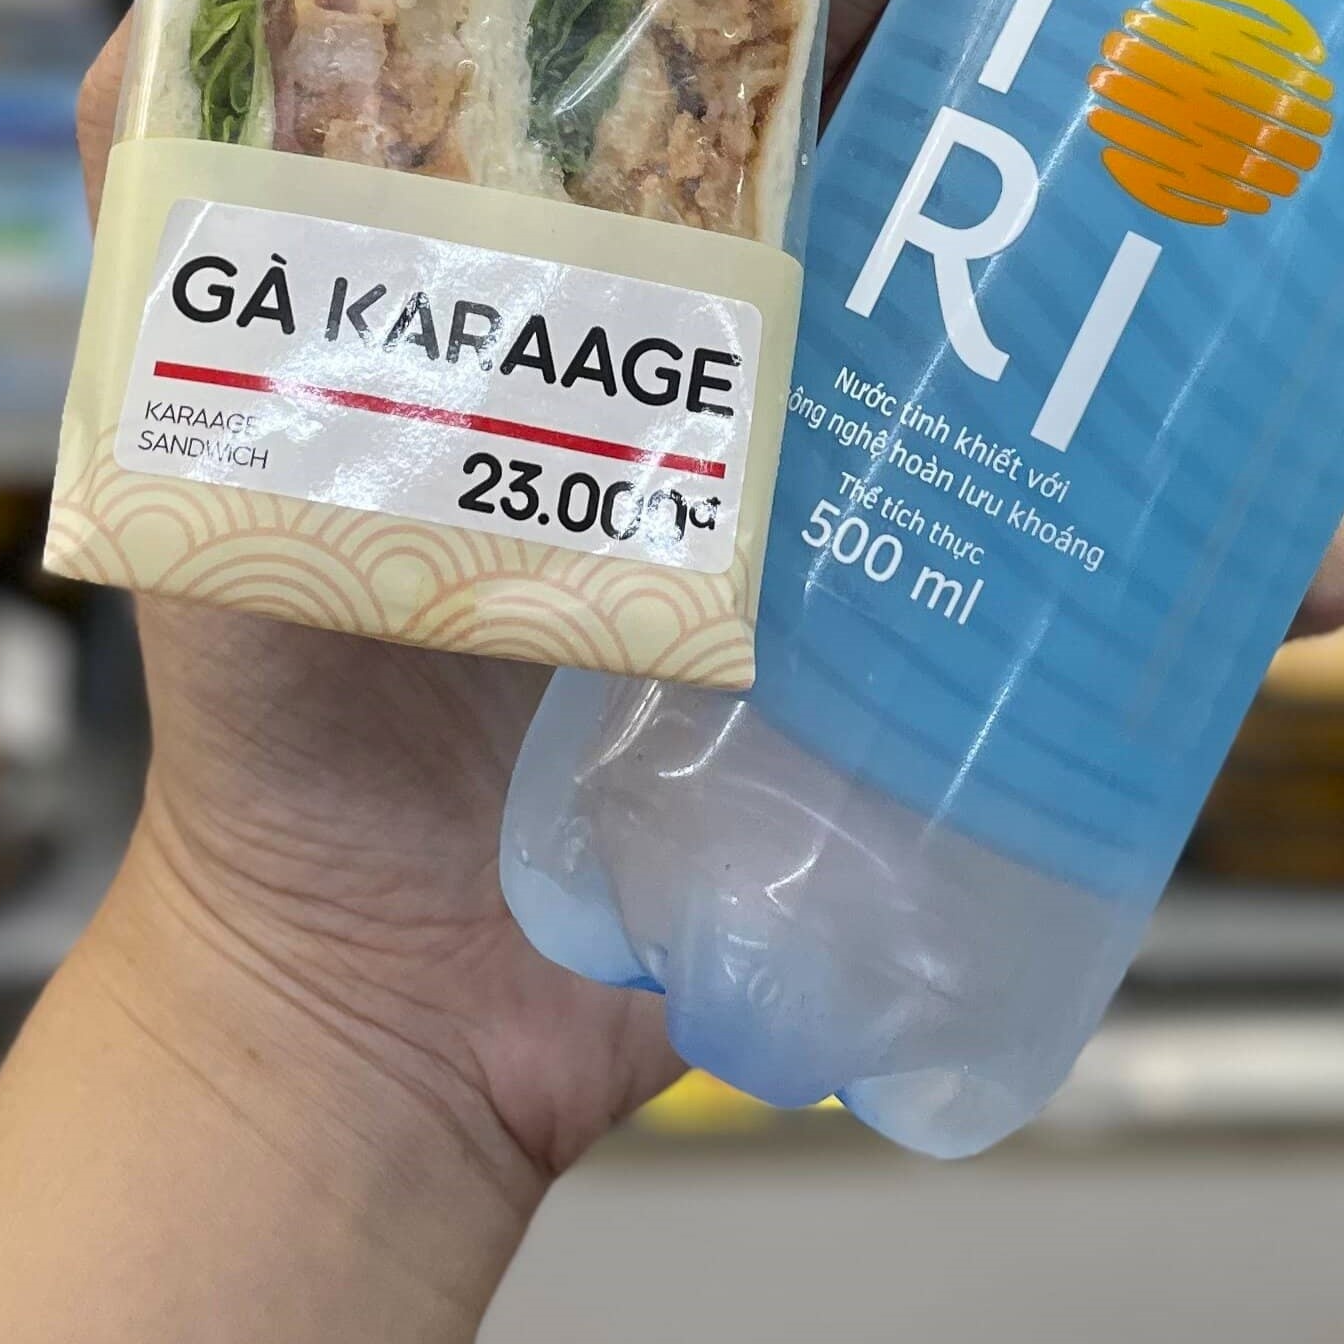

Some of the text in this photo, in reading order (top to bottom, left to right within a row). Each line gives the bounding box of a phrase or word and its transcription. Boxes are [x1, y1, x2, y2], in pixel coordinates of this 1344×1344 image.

[172, 254, 742, 417] GÀ KARAAGE
[137, 430, 269, 469] SANDWICH
[788, 385, 1105, 572] ông nghệ hoàn lưu khoáng
[834, 366, 897, 417] Nước
[954, 426, 1024, 482] khiết
[1027, 468, 1071, 503] với
[801, 498, 985, 625] 500 ml
[838, 471, 985, 566] Thể tích thực
